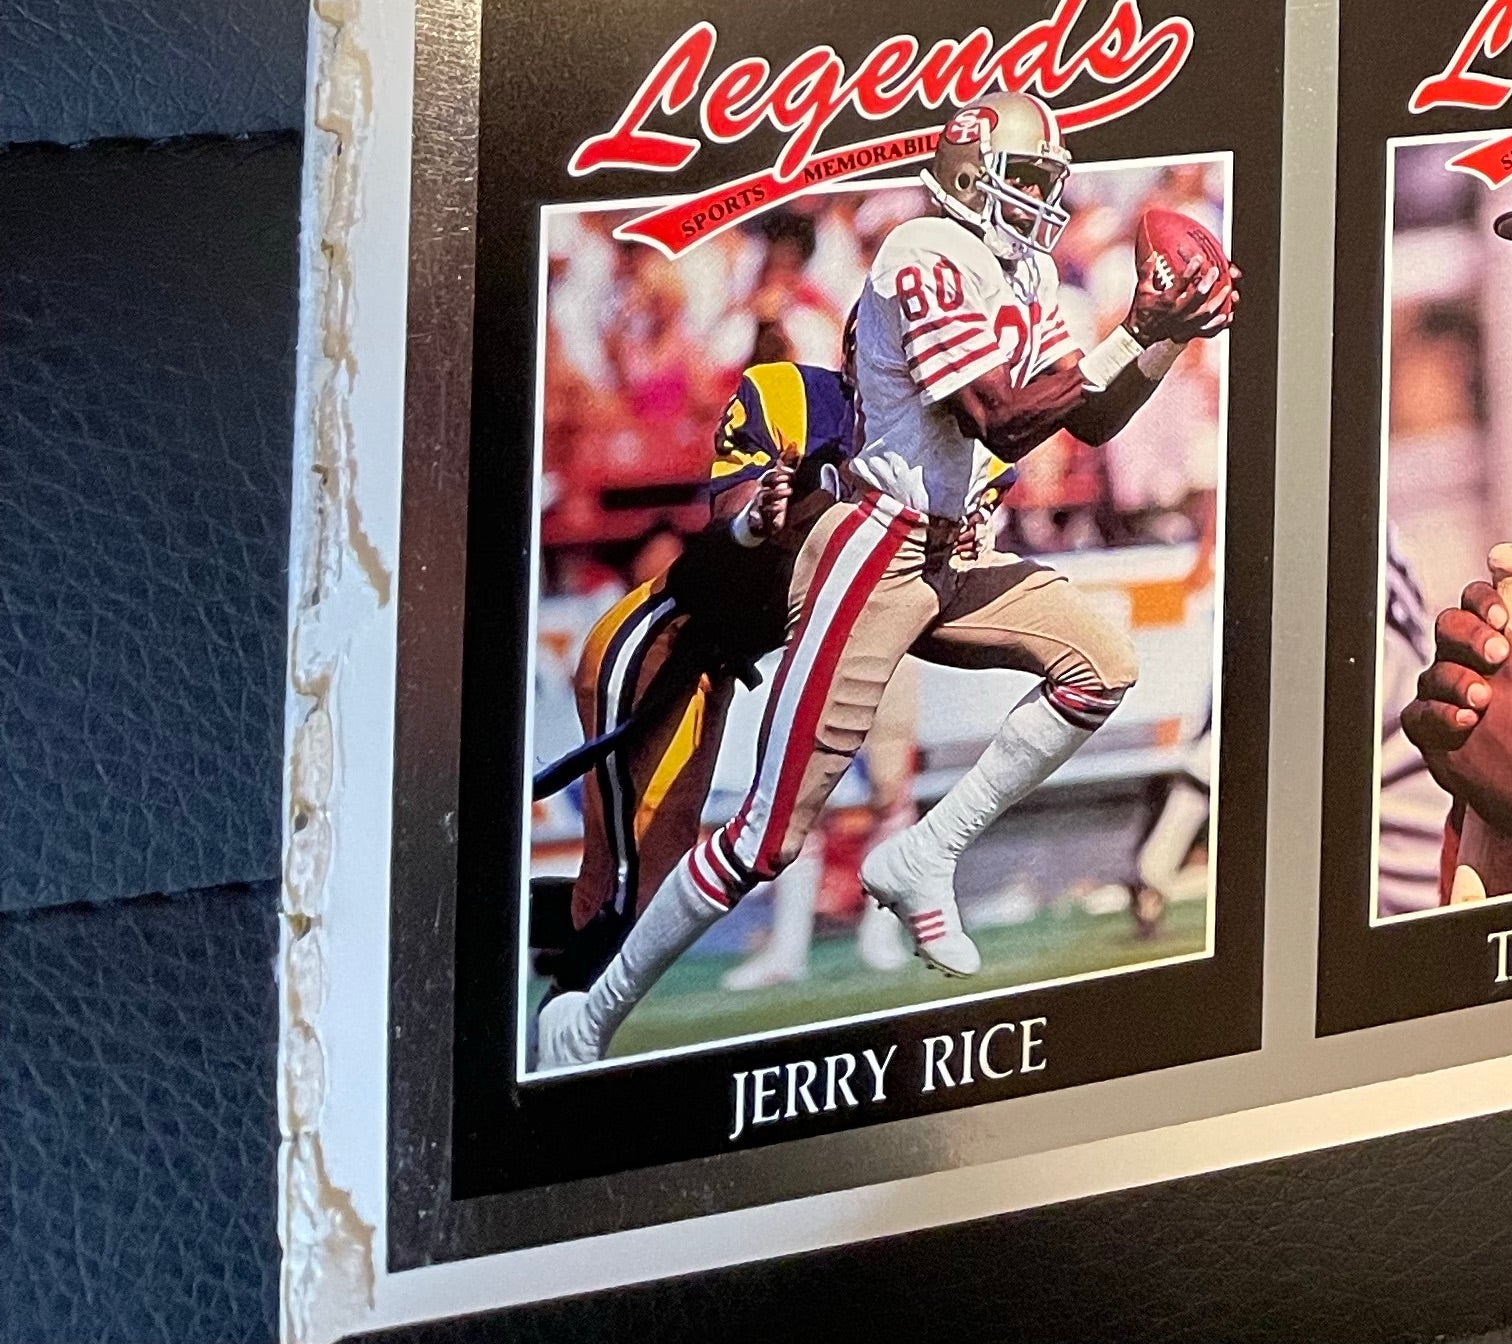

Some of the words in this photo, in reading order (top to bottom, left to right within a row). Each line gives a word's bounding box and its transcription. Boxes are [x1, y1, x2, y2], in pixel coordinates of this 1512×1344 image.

[680, 184, 766, 238] SPORTS
[803, 134, 938, 184] MEMORABIL
[896, 254, 964, 322] 80
[729, 1045, 898, 1140] JERRY
[922, 1017, 1048, 1092] RICE
